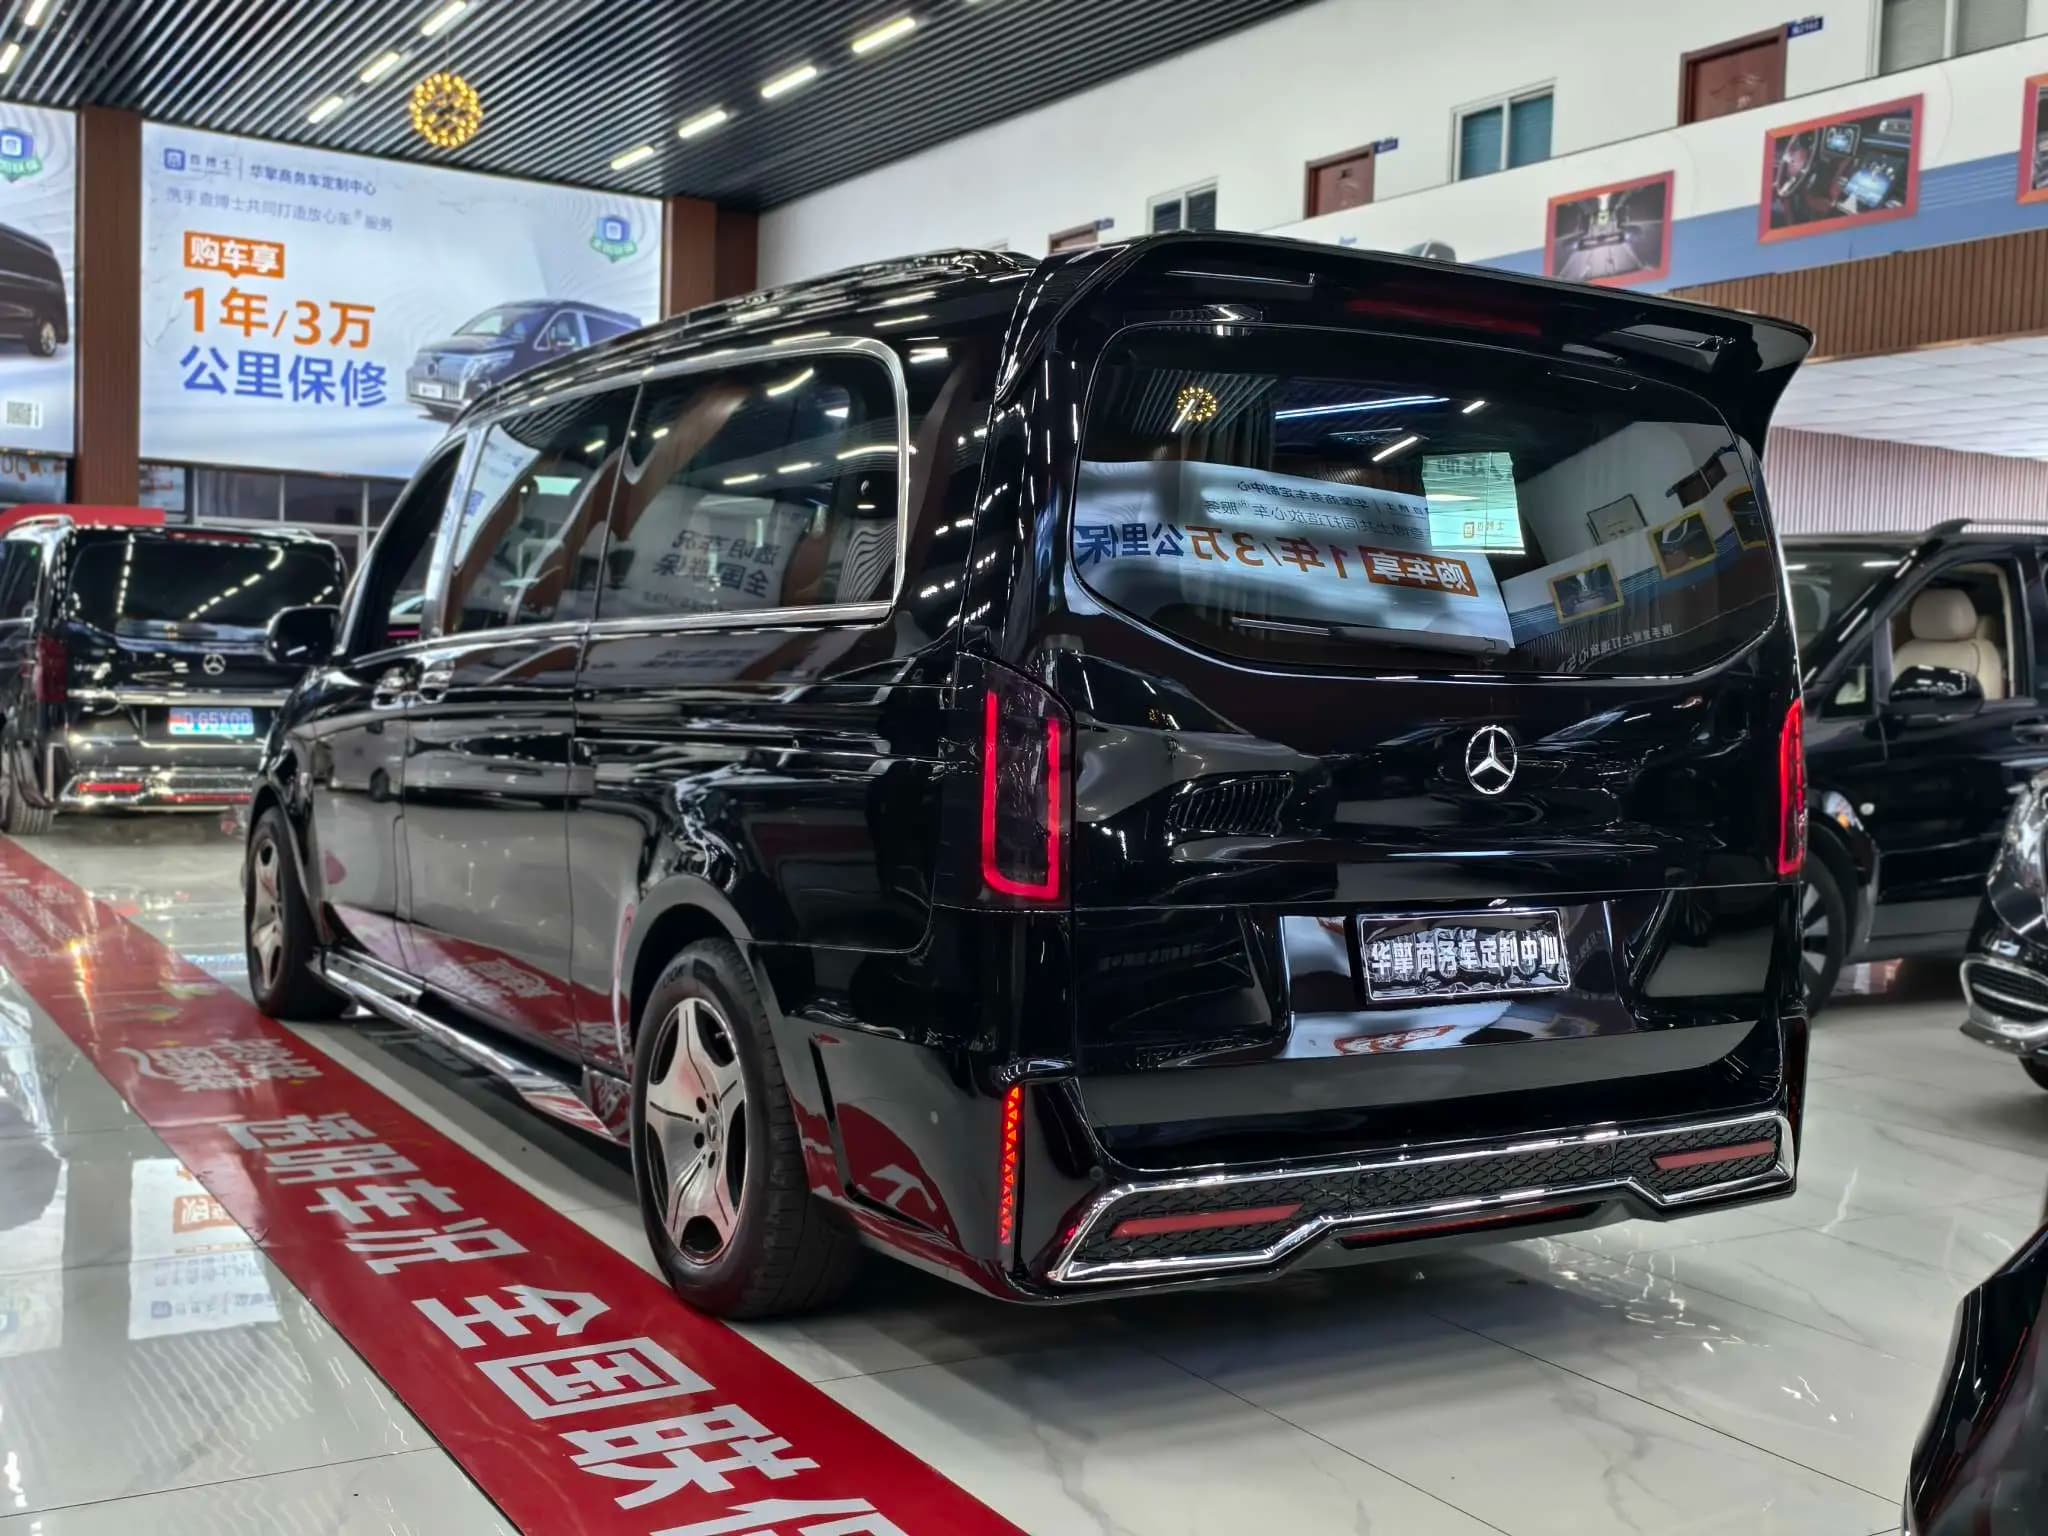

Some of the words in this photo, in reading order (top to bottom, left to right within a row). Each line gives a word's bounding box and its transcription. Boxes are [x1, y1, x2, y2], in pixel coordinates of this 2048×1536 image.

[190, 235, 280, 274] 购车享
[183, 286, 376, 349] 1年/3万
[179, 345, 388, 408] 公里保修
[219, 1111, 530, 1275] 透明车况
